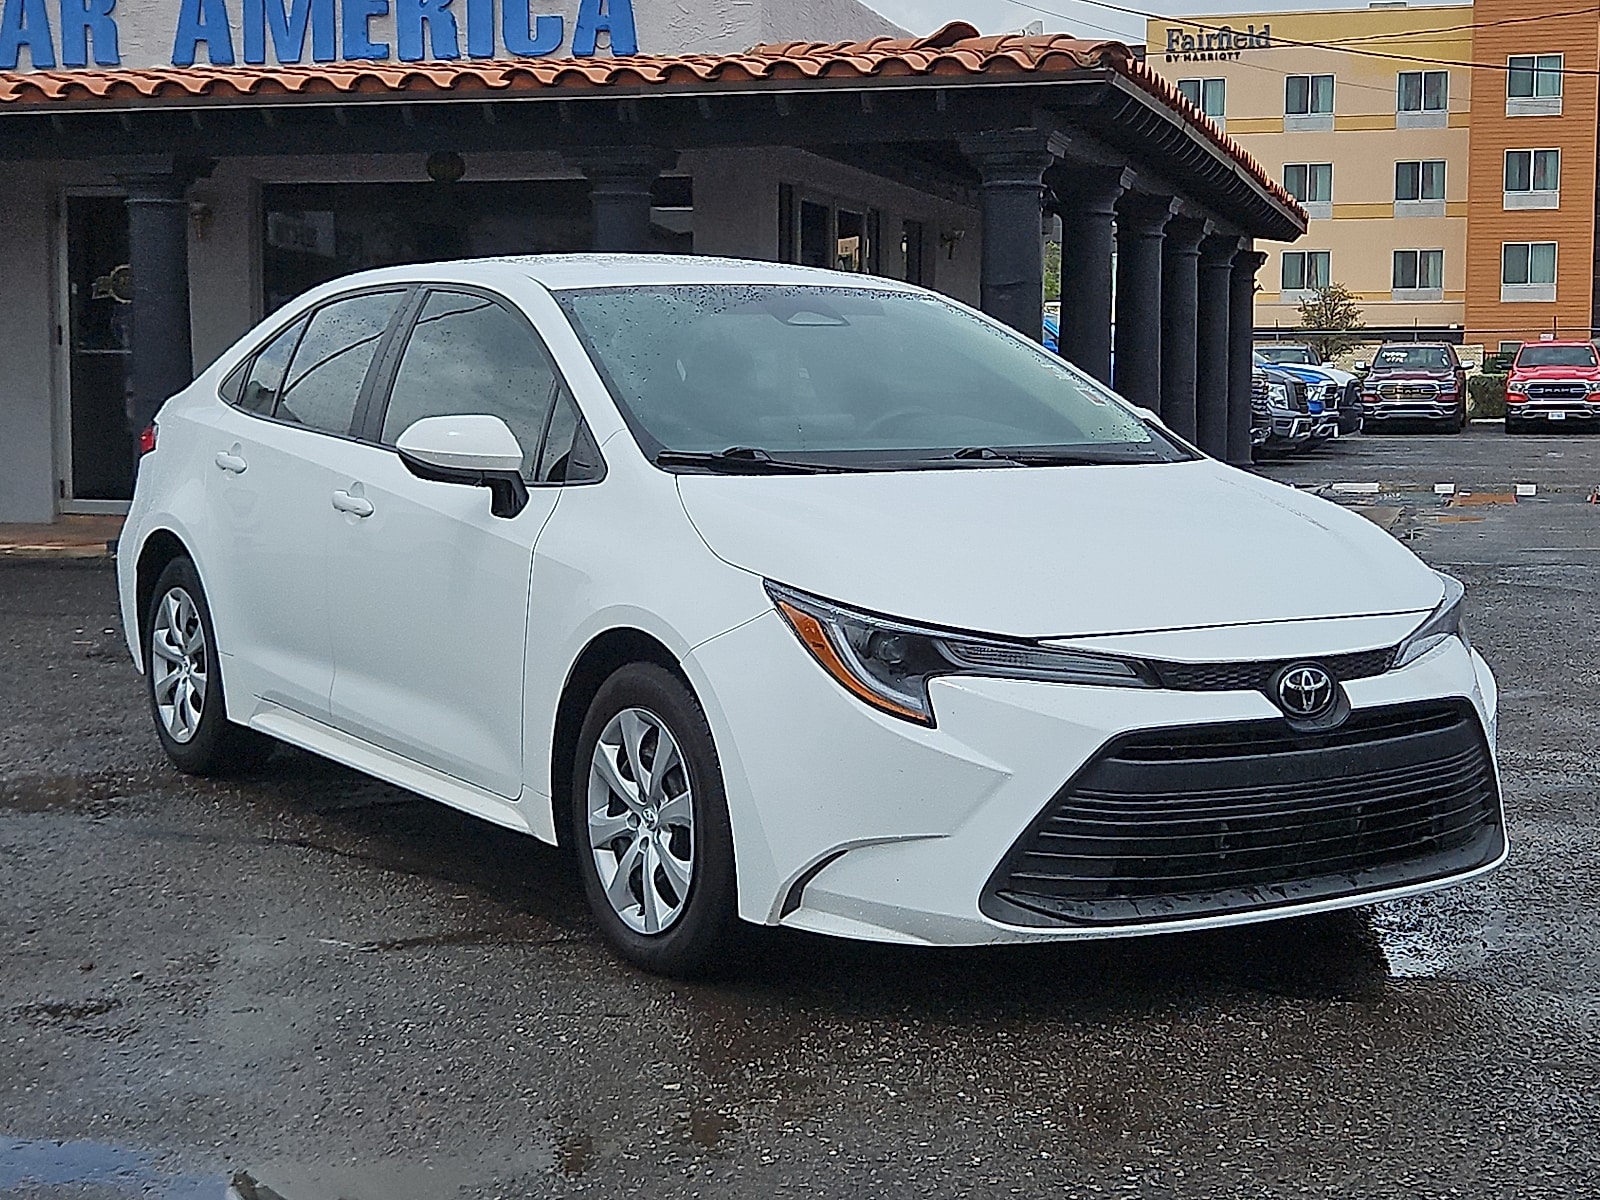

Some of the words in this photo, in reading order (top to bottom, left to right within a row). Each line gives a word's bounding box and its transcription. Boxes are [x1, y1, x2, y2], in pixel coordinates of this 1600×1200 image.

[0, 0, 120, 70] AR
[171, 0, 639, 66] AMERICA
[1165, 25, 1271, 51] Fairfield
[1183, 52, 1241, 62] MARRIOTT
